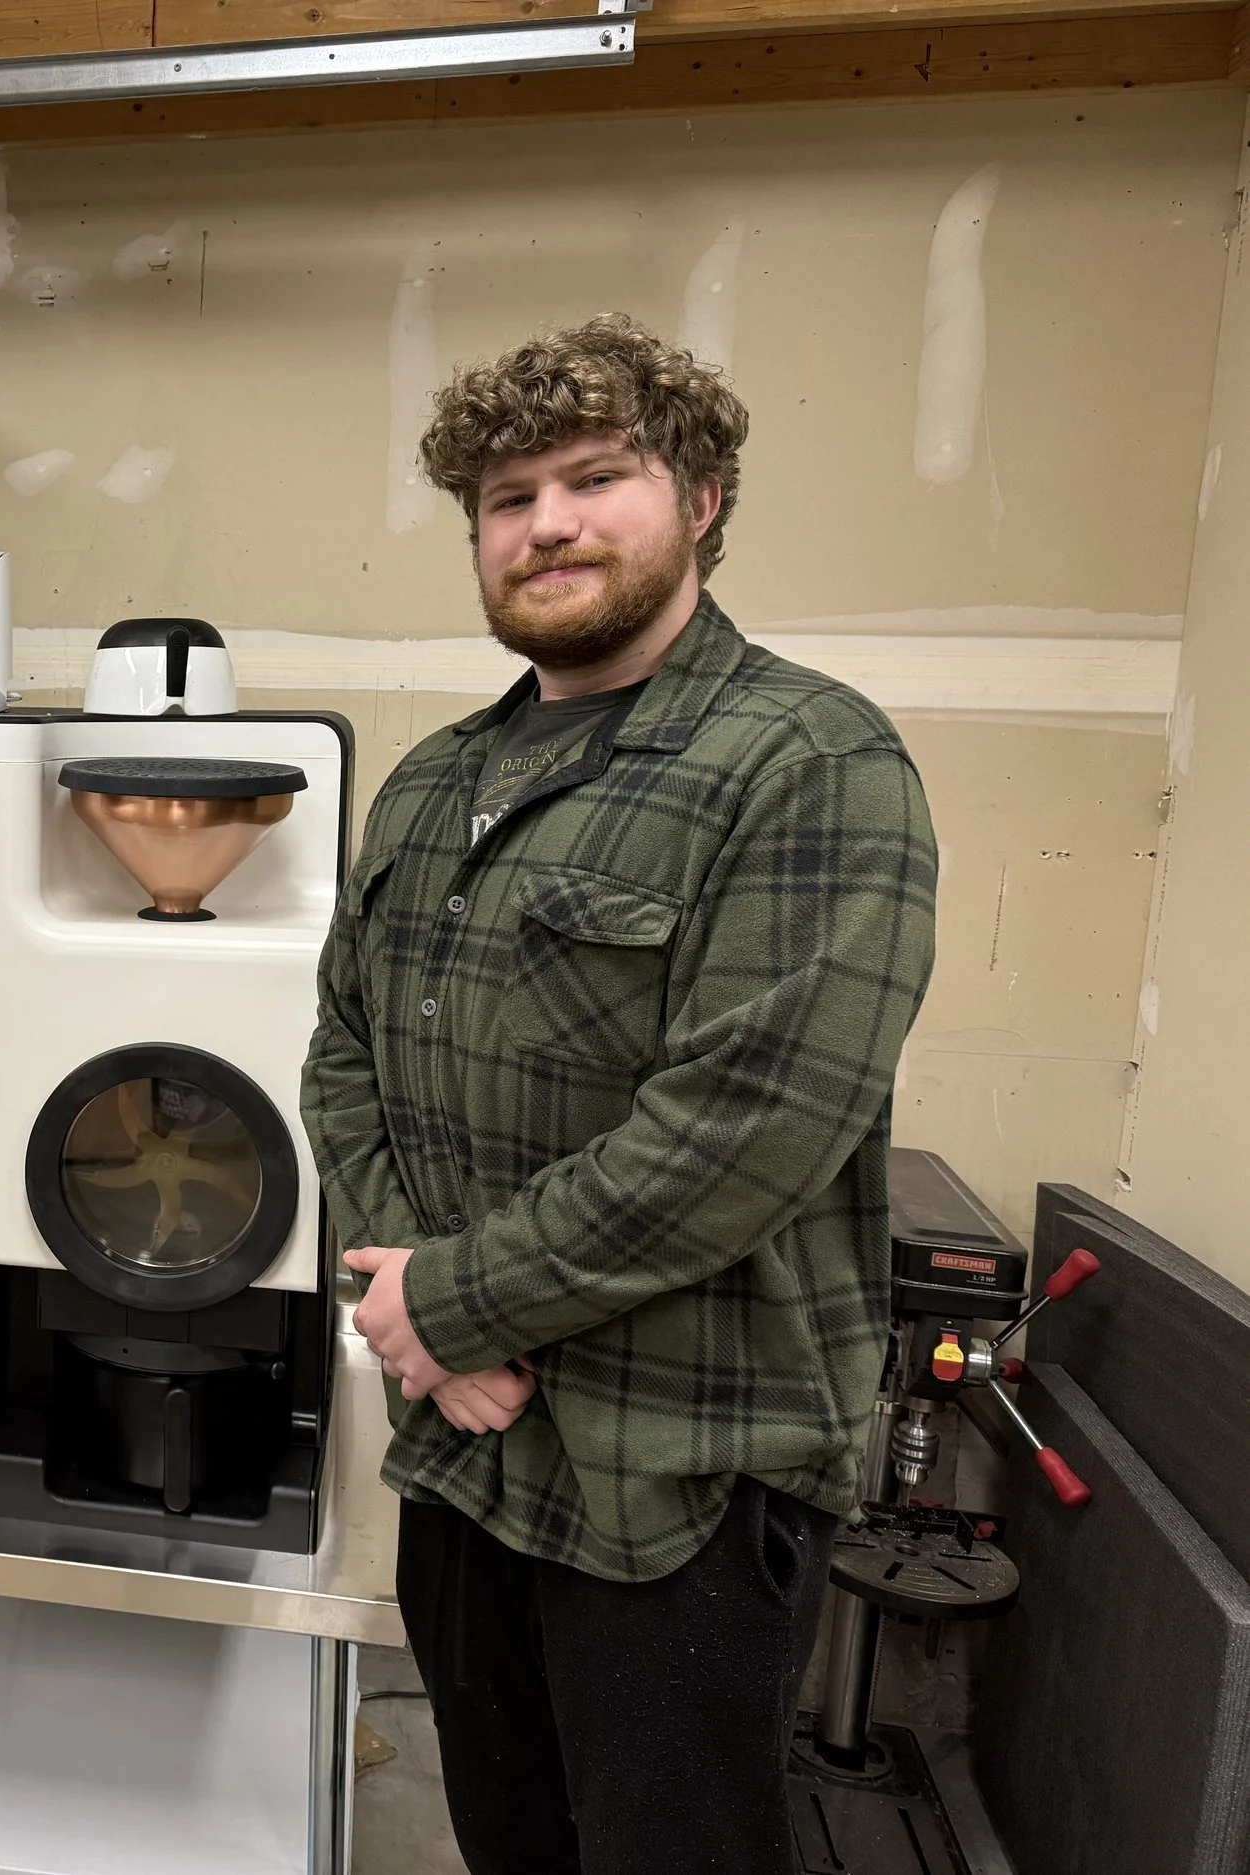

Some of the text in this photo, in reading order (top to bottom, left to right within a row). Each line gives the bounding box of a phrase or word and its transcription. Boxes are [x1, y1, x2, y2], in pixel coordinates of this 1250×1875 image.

[935, 1256, 993, 1271] CRAFTSMAN
[973, 1274, 996, 1283] 1/2 HP
